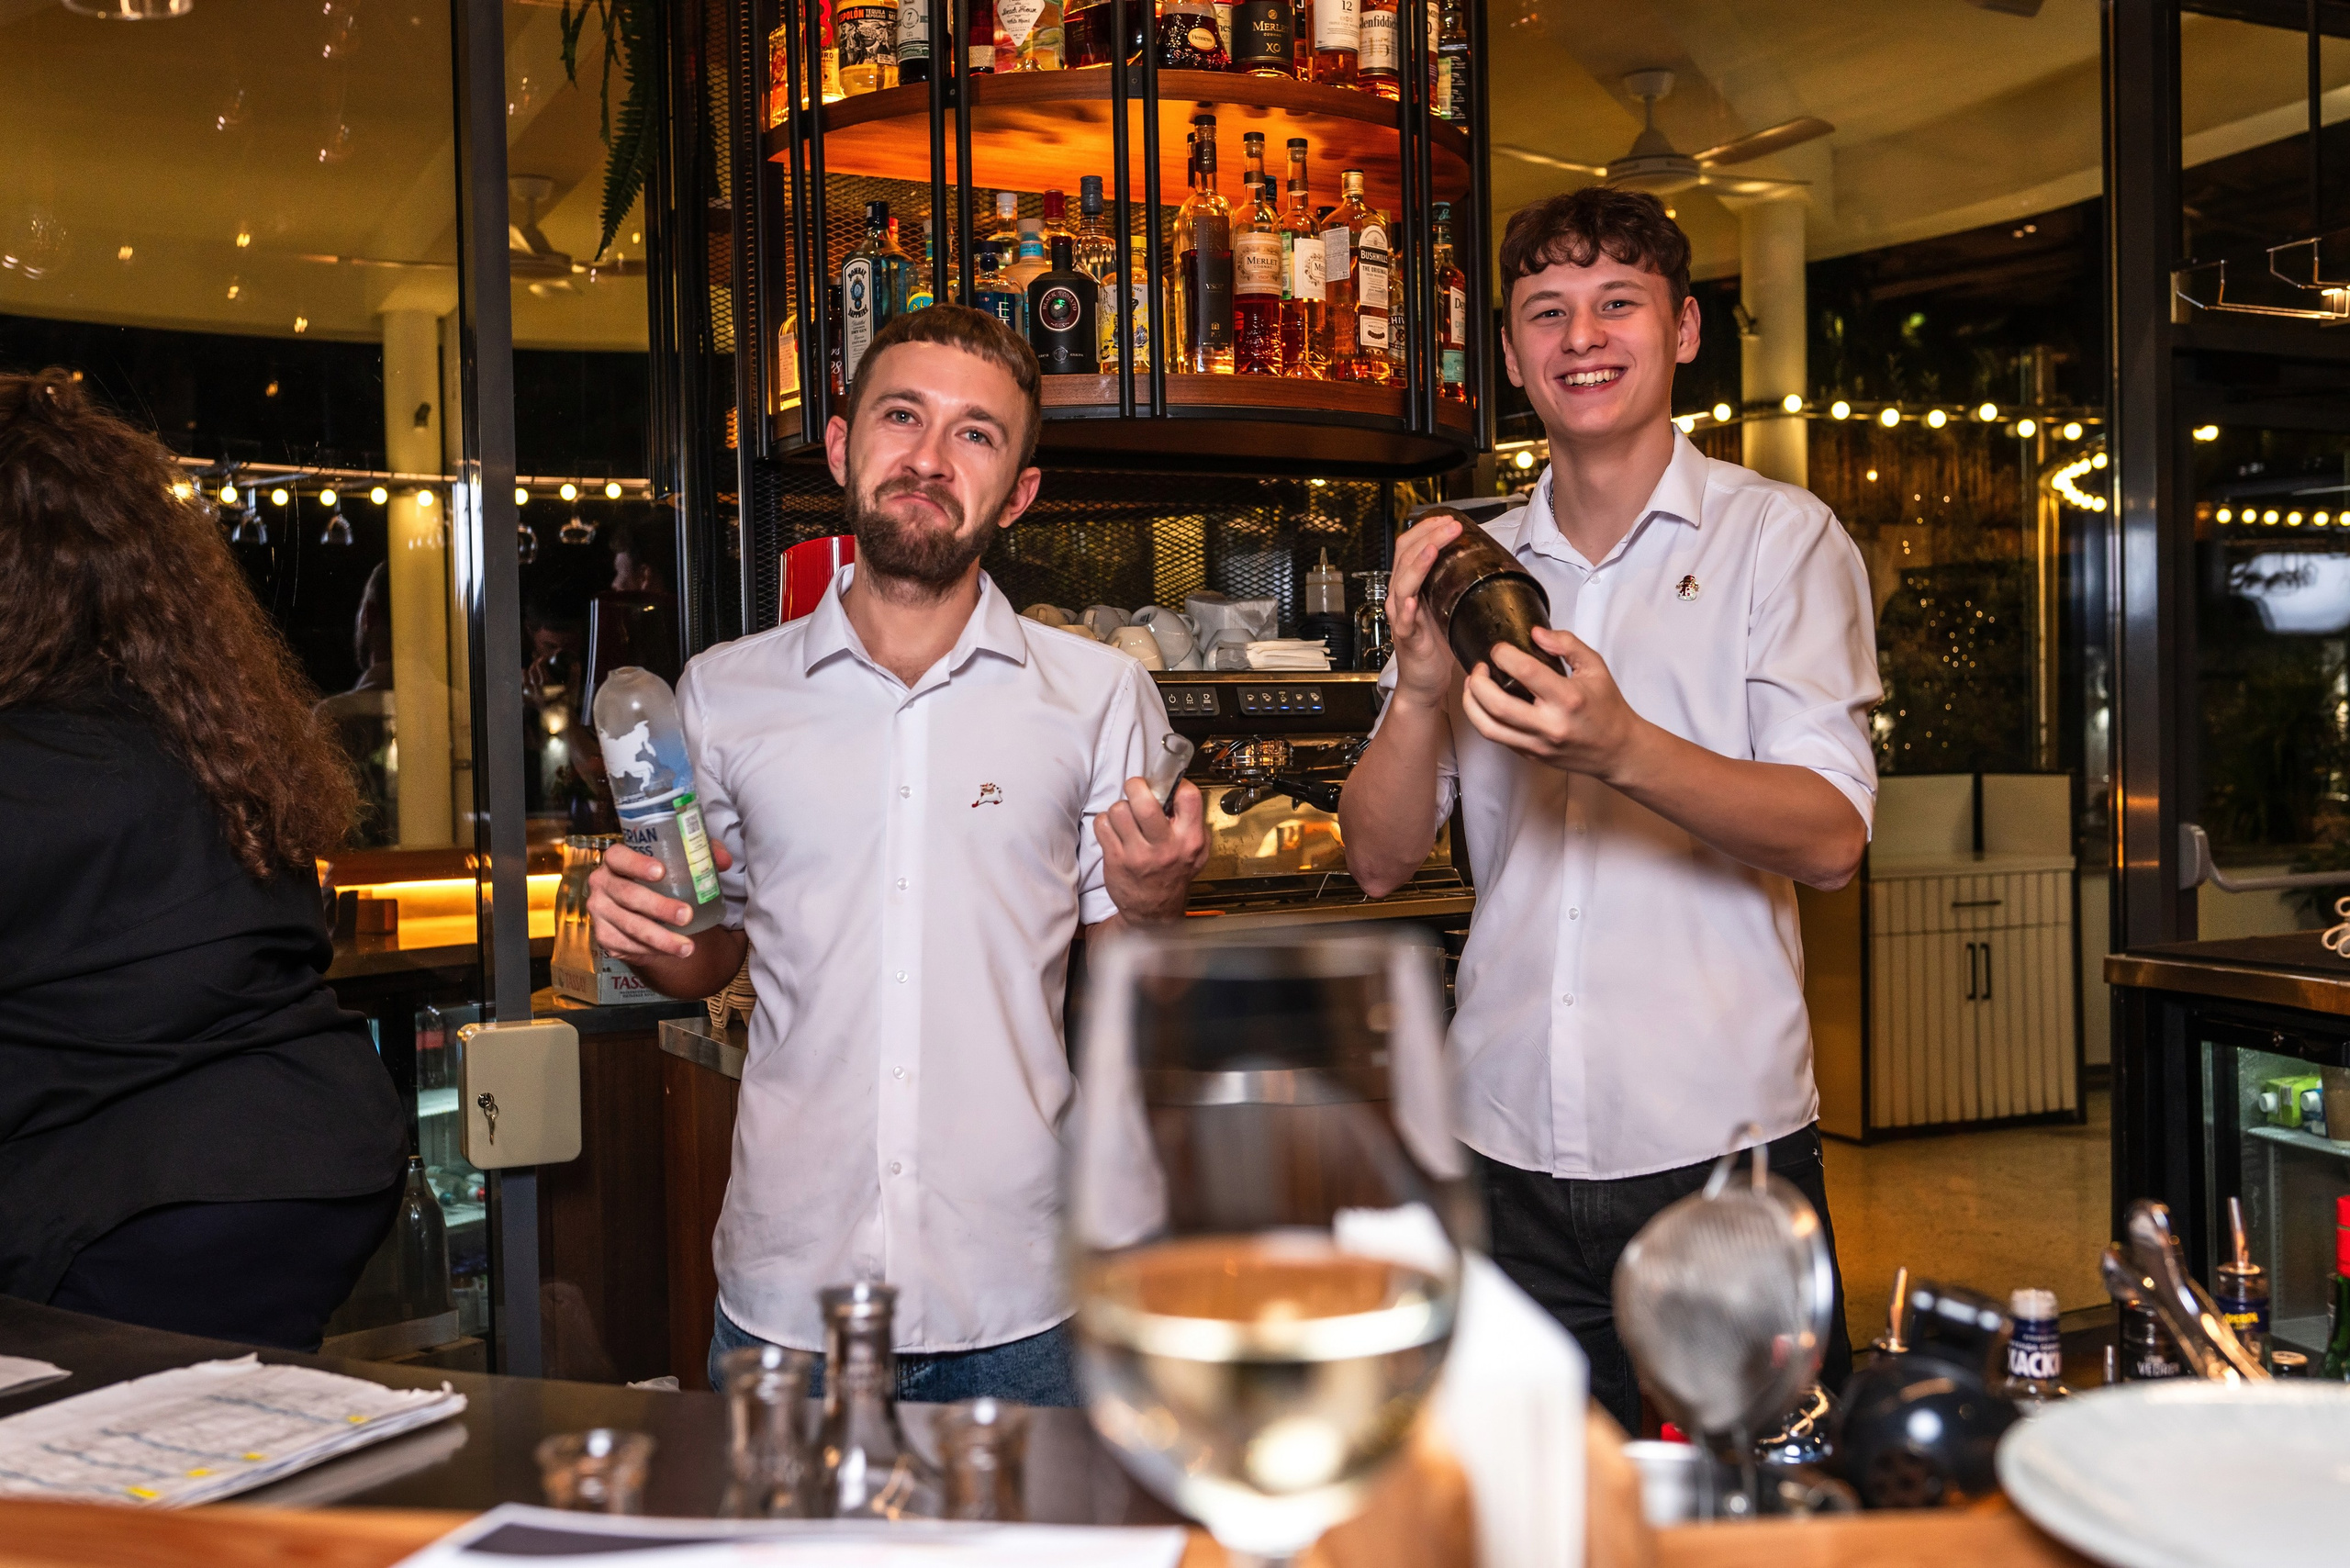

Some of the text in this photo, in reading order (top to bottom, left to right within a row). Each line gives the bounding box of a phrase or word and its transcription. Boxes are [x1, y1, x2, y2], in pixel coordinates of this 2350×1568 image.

[1342, 0, 1353, 11] 12
[907, 12, 913, 21] 7
[1266, 42, 1281, 54] XO
[1247, 256, 1278, 266] MERLET
[1360, 250, 1388, 263] BUSHMILLS
[847, 267, 867, 281] BOMBAY
[1043, 291, 1057, 310] BLACK
[847, 304, 869, 319] SAPPHIRE
